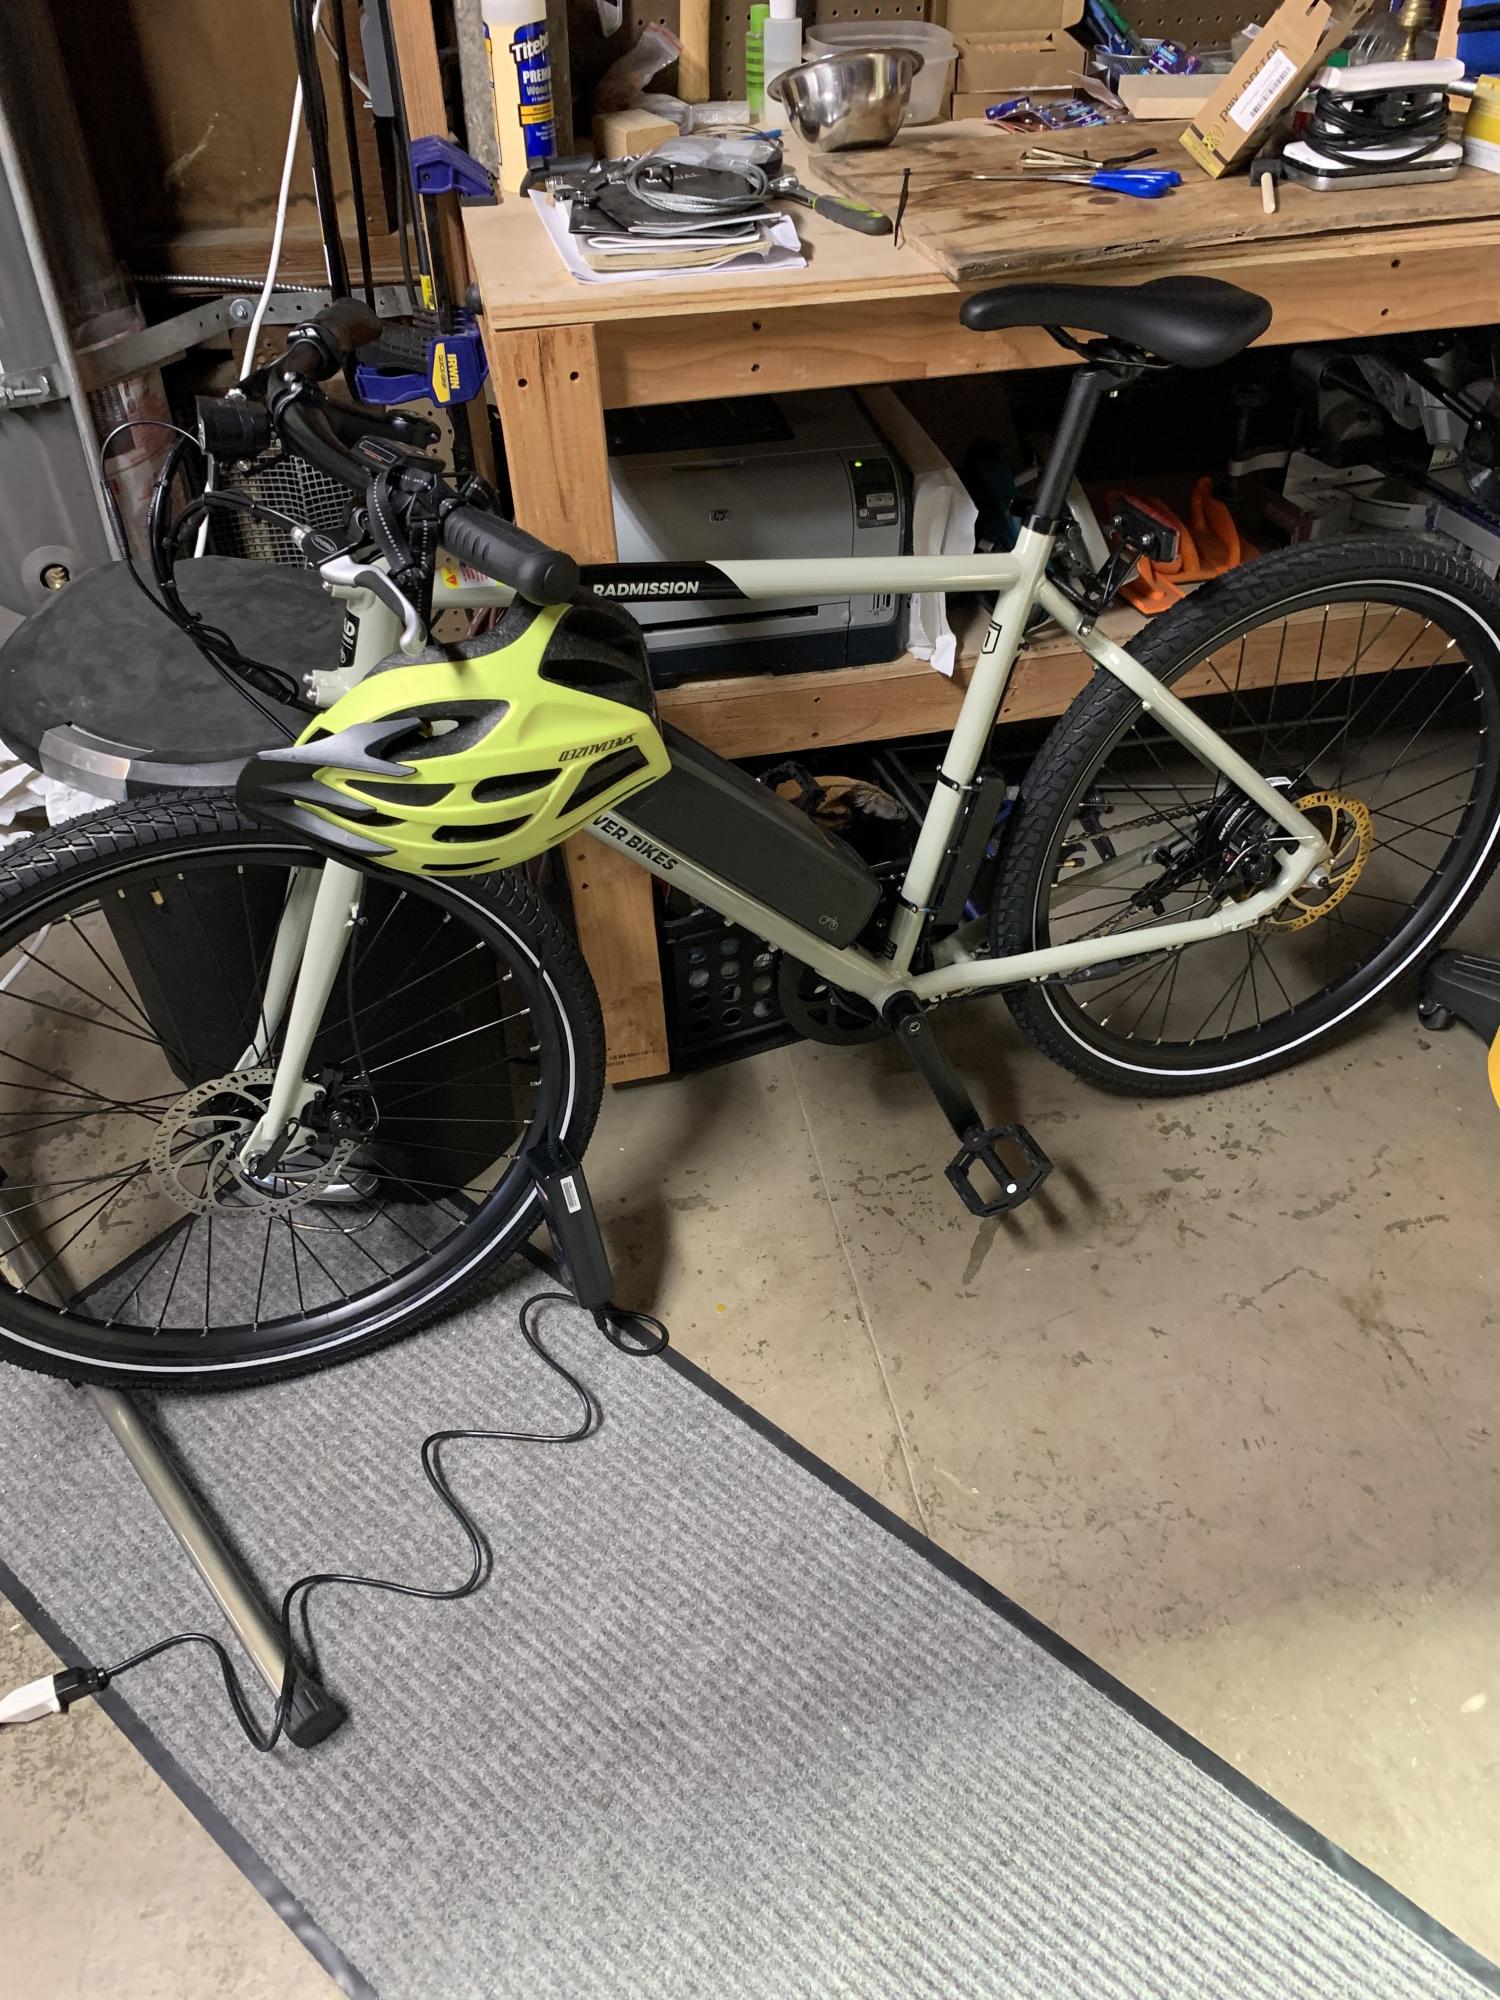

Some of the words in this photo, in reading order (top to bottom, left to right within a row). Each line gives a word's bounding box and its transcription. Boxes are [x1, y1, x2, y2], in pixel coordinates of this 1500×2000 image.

[447, 353, 460, 389] IRWIN
[593, 581, 699, 596] RADMISSION
[558, 732, 637, 762] SPECIALIZED
[625, 834, 679, 870] BIKES
